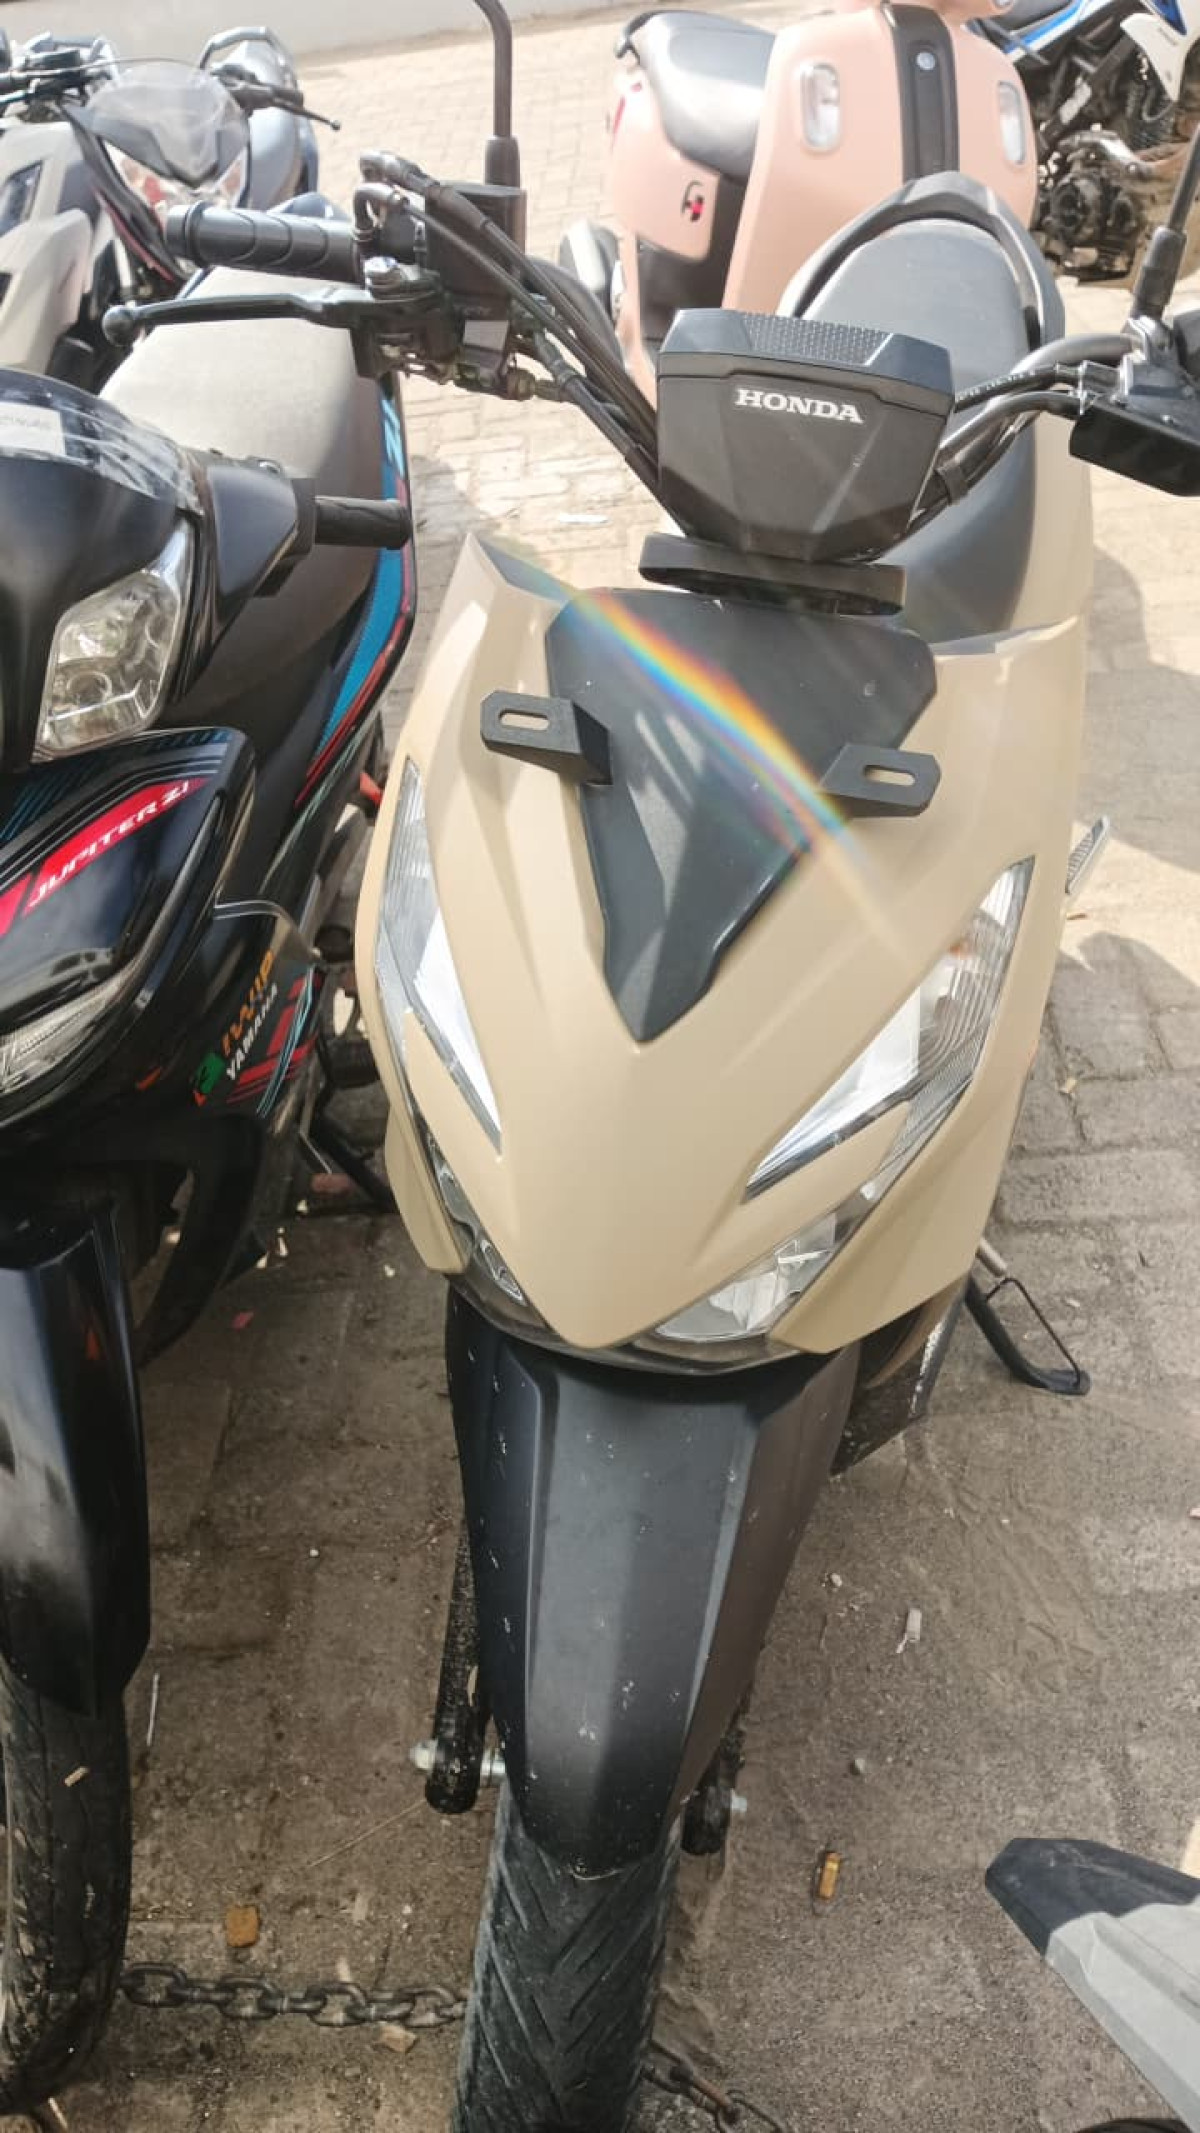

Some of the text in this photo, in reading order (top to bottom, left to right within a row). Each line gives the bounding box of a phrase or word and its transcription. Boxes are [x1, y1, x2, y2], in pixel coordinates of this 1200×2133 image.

[734, 389, 864, 424] HONDA
[28, 801, 157, 908] JUPITER
[226, 982, 278, 1080] YAMAHA
